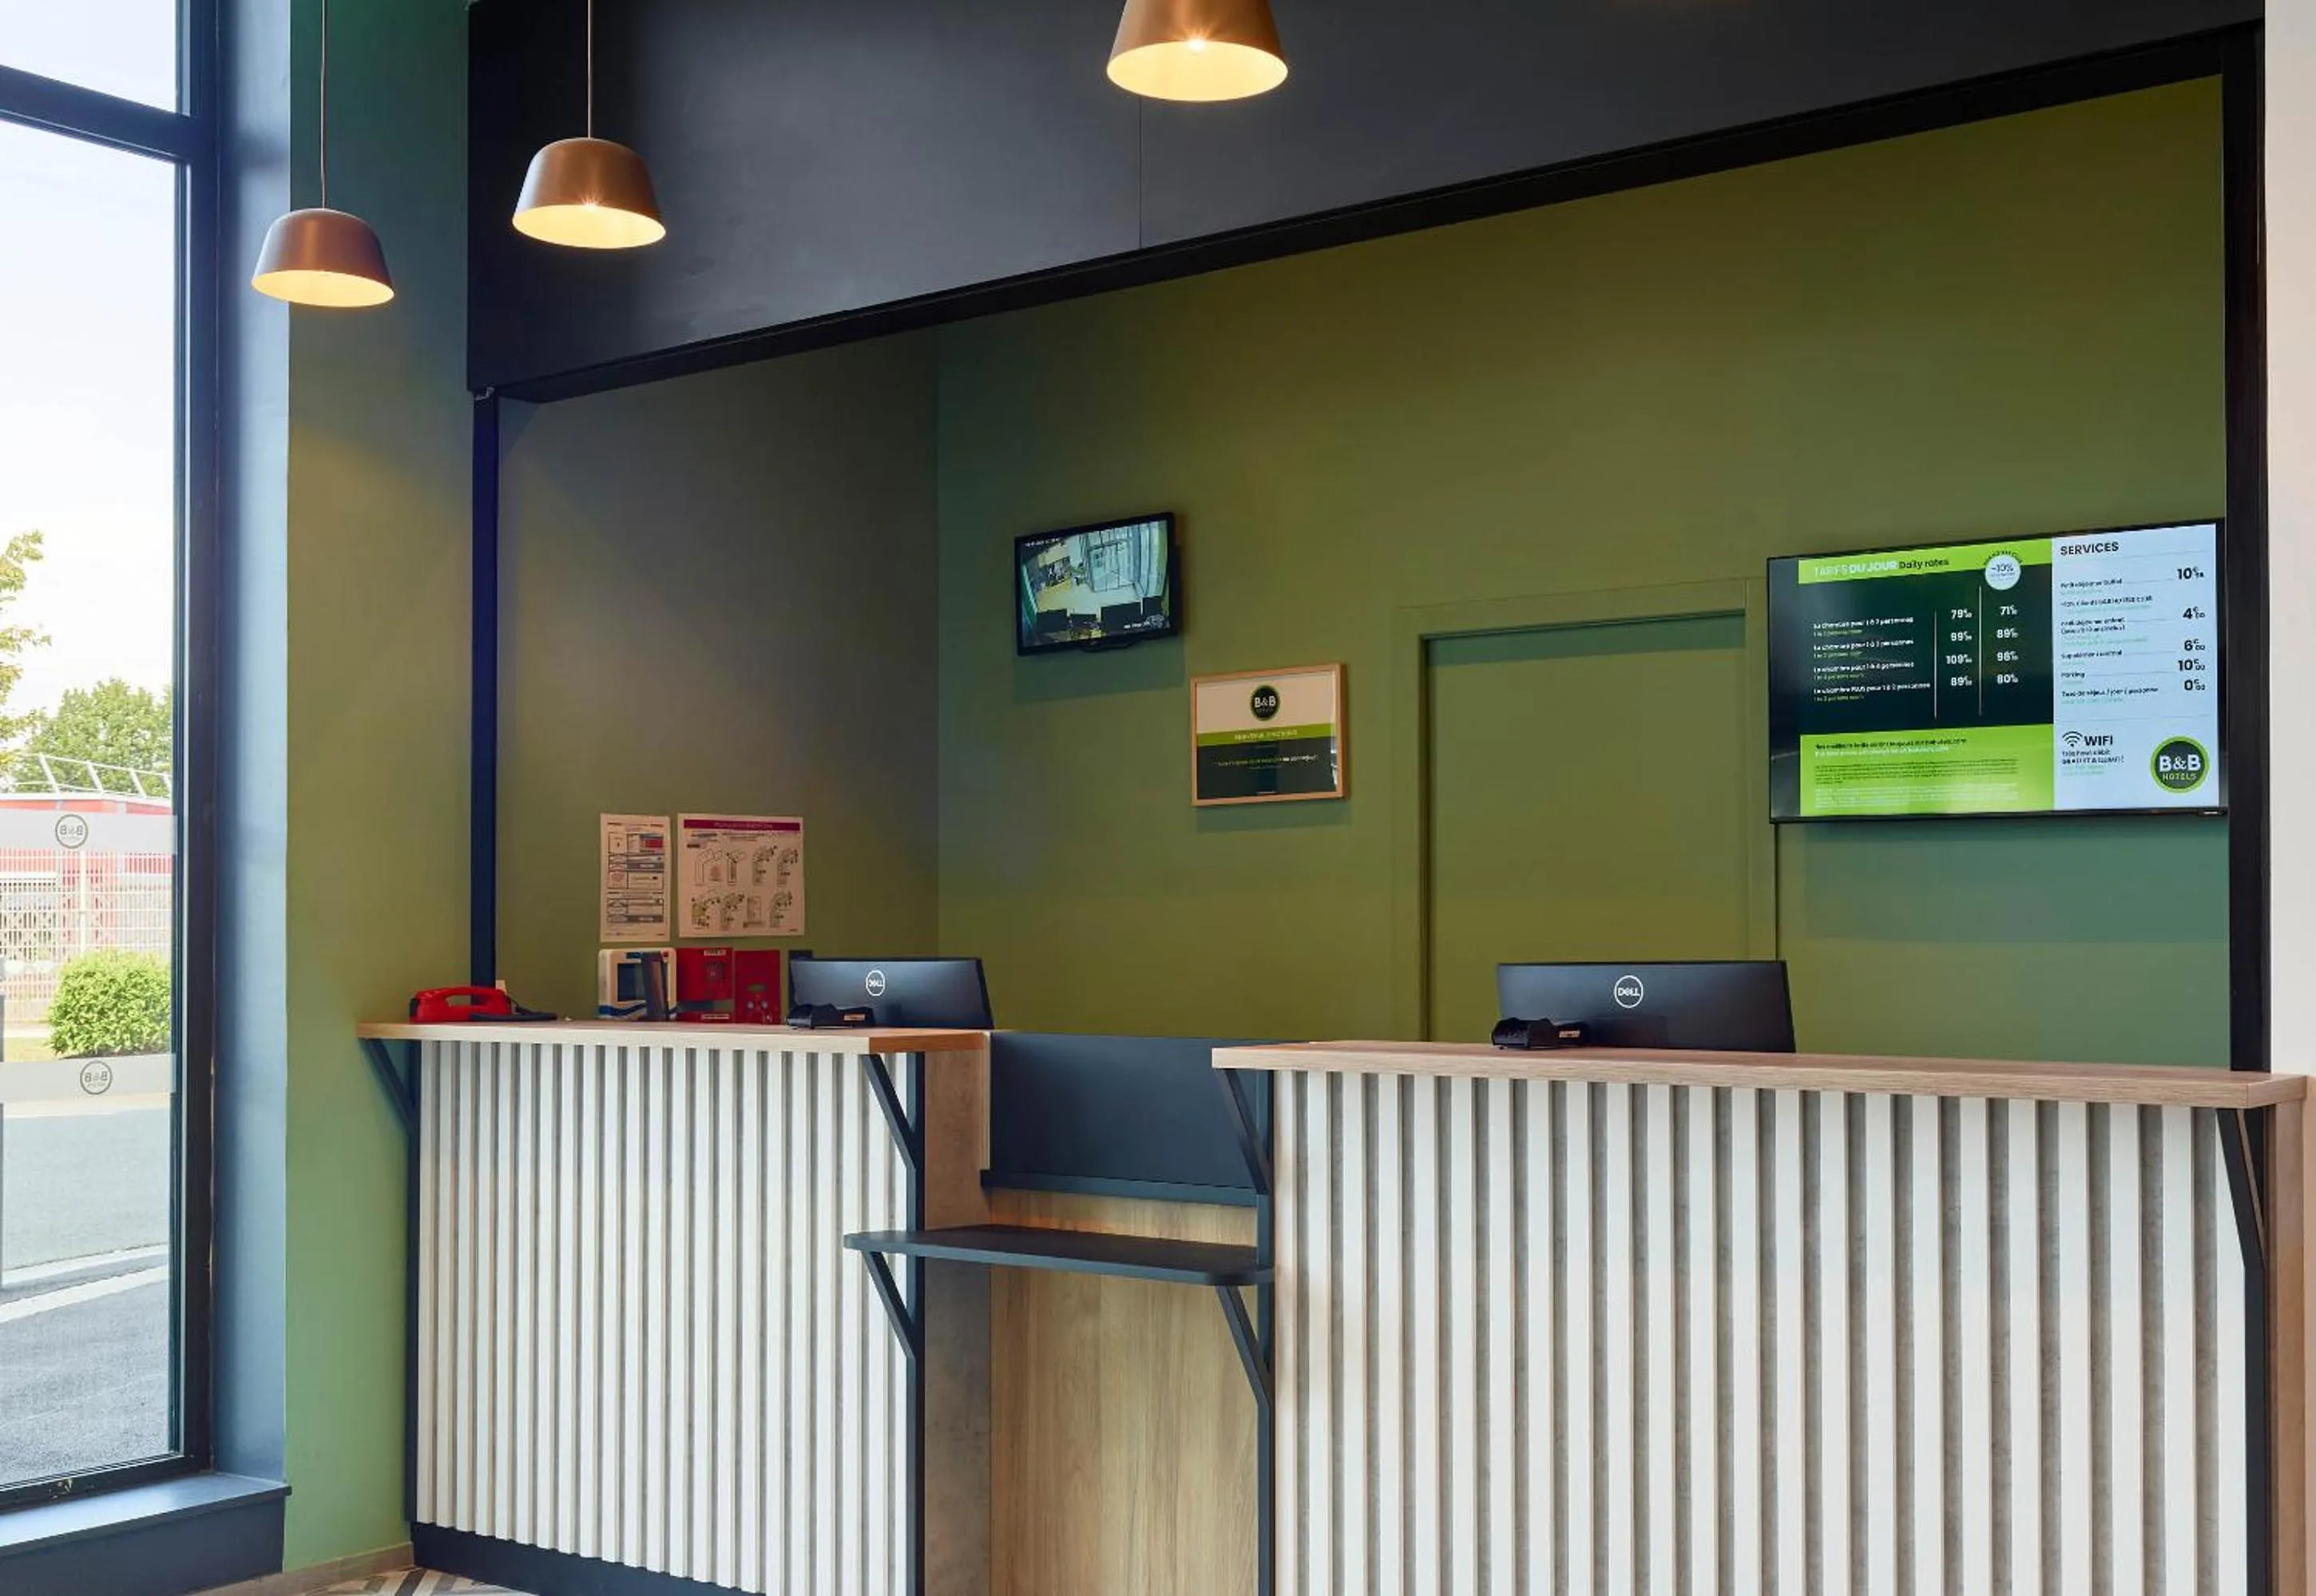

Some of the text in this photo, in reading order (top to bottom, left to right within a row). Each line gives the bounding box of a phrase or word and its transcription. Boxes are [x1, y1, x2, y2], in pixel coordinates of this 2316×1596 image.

[2060, 541, 2120, 556] SERVICES
[1255, 695, 1276, 708] B&B
[2084, 735, 2113, 747] WIFI
[2159, 754, 2201, 772] B&B
[2162, 772, 2197, 781] HOTELS
[1617, 987, 1640, 997] DELL
